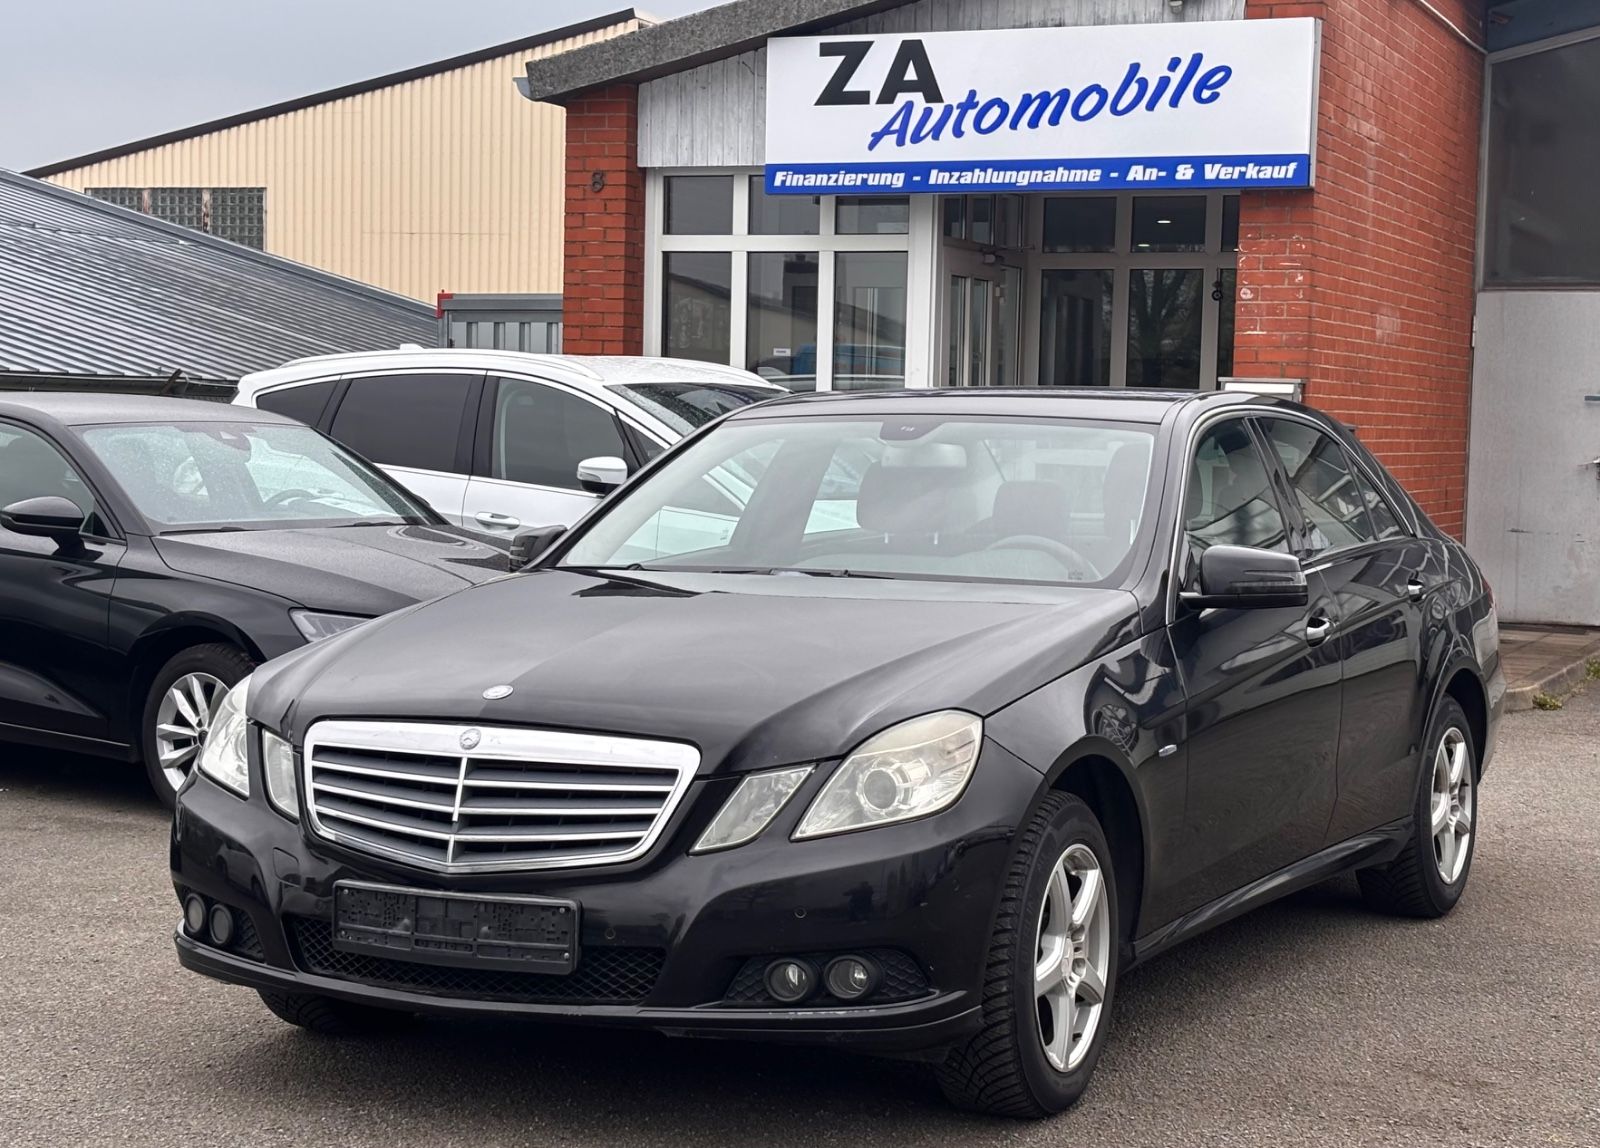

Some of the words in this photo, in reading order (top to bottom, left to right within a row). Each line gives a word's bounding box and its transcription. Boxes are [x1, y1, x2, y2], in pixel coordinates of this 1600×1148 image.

[814, 39, 944, 106] ZA
[868, 52, 1233, 150] Automobile
[592, 171, 605, 193] 8
[774, 171, 905, 188] Finanzierung
[928, 167, 1102, 187] Inzahlungnahme
[1126, 165, 1167, 182] An-
[1175, 163, 1195, 181] &
[1204, 161, 1299, 181] Verkauf
